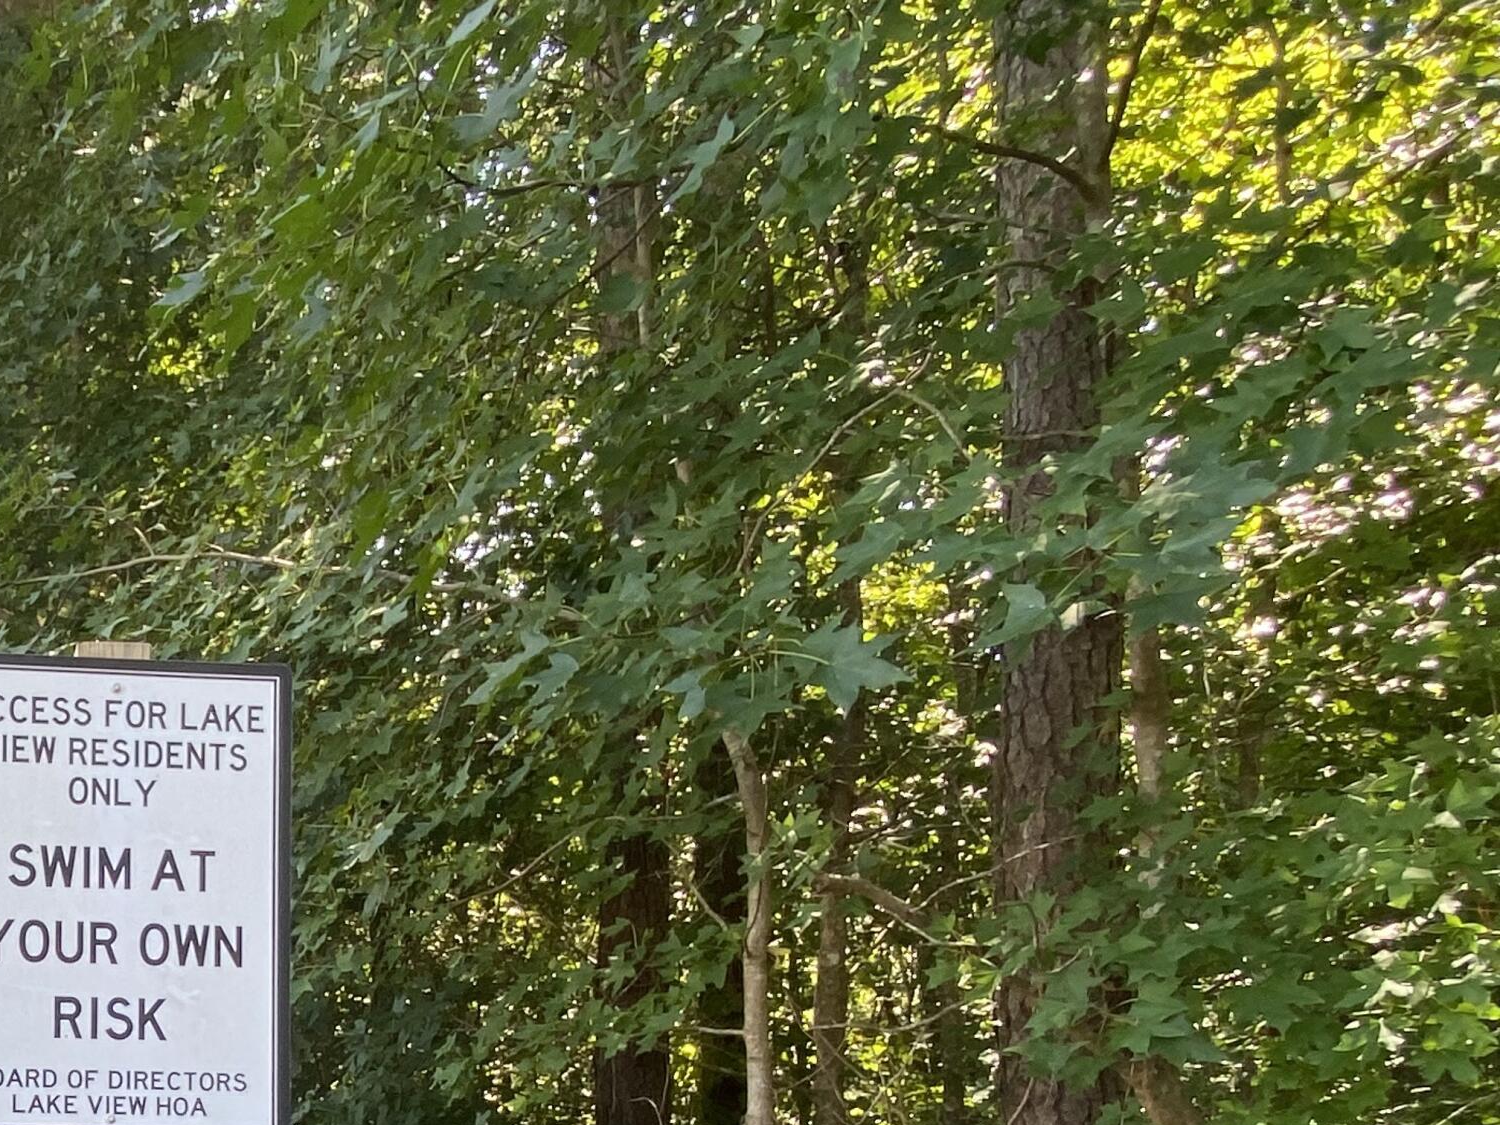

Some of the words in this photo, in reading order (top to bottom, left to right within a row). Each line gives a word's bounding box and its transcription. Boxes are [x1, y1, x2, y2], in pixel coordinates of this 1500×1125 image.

[104, 699, 167, 730] FOR
[180, 702, 265, 734] LAKE
[68, 736, 248, 772] RESIDENTS
[68, 776, 157, 808] ONLY
[7, 843, 132, 891] SWIM
[150, 848, 216, 893] AT
[139, 922, 243, 969] OWN
[53, 995, 167, 1042] RISK
[67, 1069, 99, 1090] OF
[108, 1069, 248, 1093] DIRECTORS
[12, 1093, 79, 1115] LAKE
[87, 1095, 148, 1116] VIEW
[156, 1096, 208, 1117] HOA
